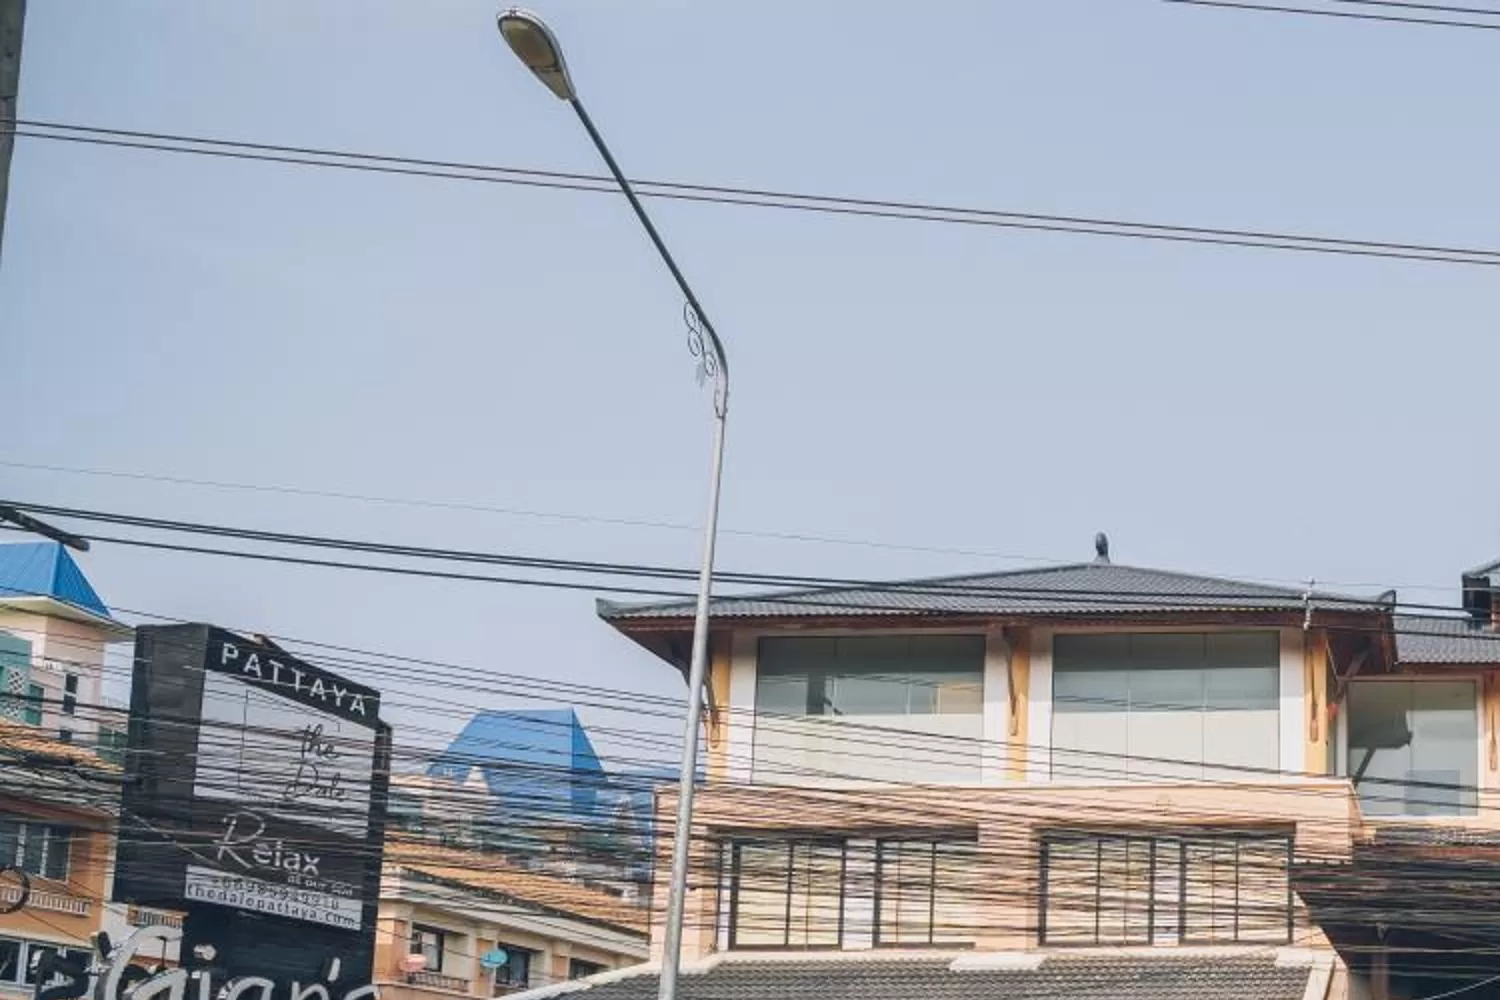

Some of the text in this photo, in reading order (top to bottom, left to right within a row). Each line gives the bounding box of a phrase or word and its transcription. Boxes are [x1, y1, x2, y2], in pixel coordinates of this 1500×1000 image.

[221, 642, 366, 716] PATTAYA
[301, 723, 338, 760] the
[213, 811, 320, 877] Relax
